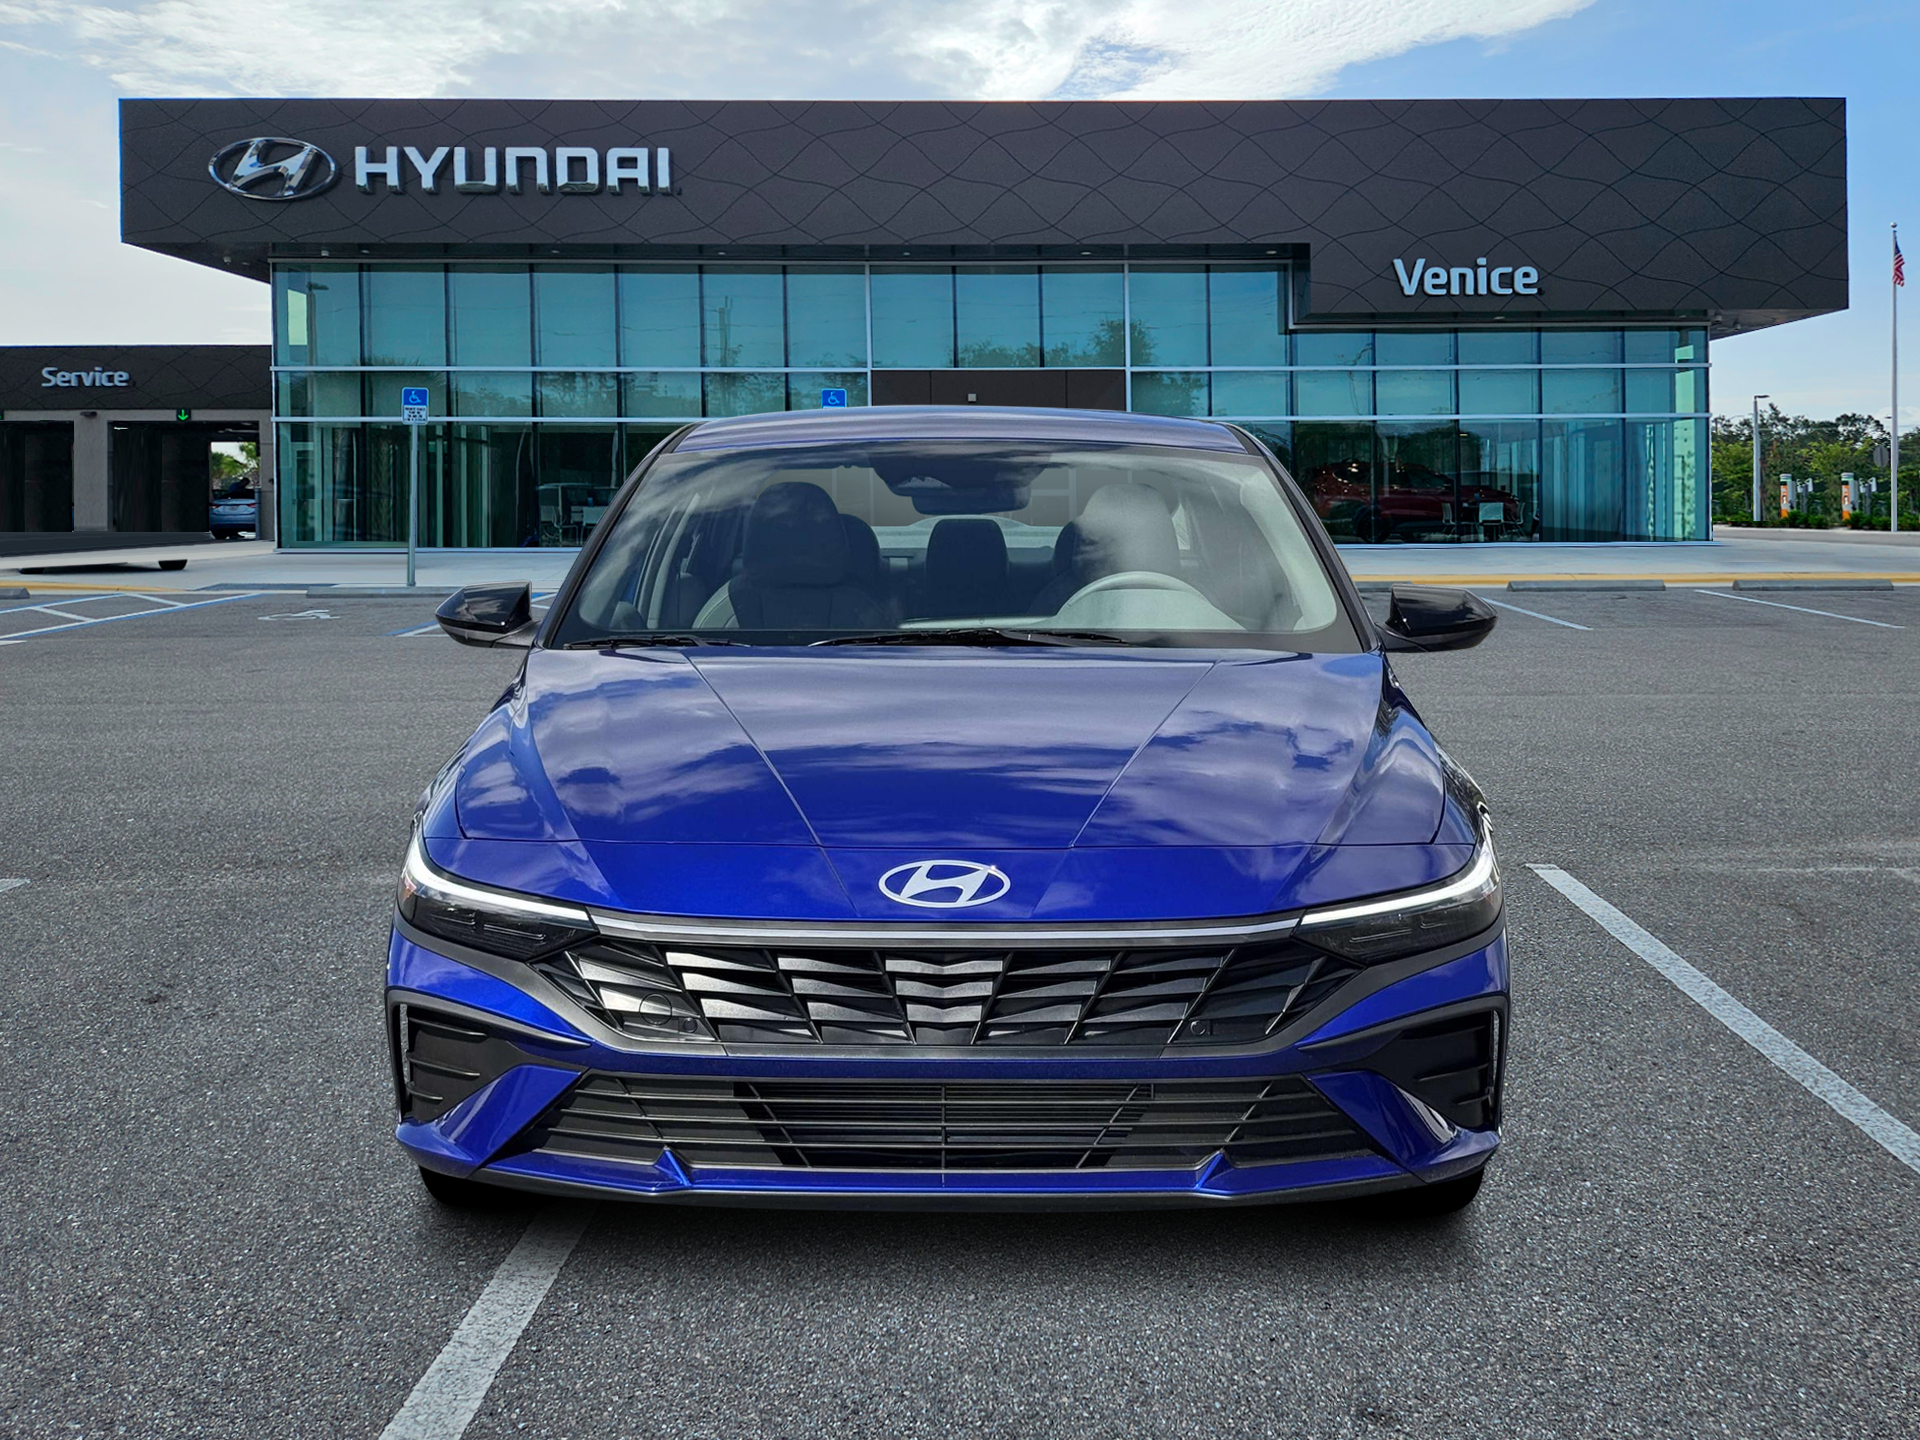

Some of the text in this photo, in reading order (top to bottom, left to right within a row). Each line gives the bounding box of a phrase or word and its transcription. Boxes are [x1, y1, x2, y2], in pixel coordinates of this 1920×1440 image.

[354, 145, 676, 195] HYUNDAI
[1393, 257, 1539, 296] Venice
[41, 367, 130, 387] Service
